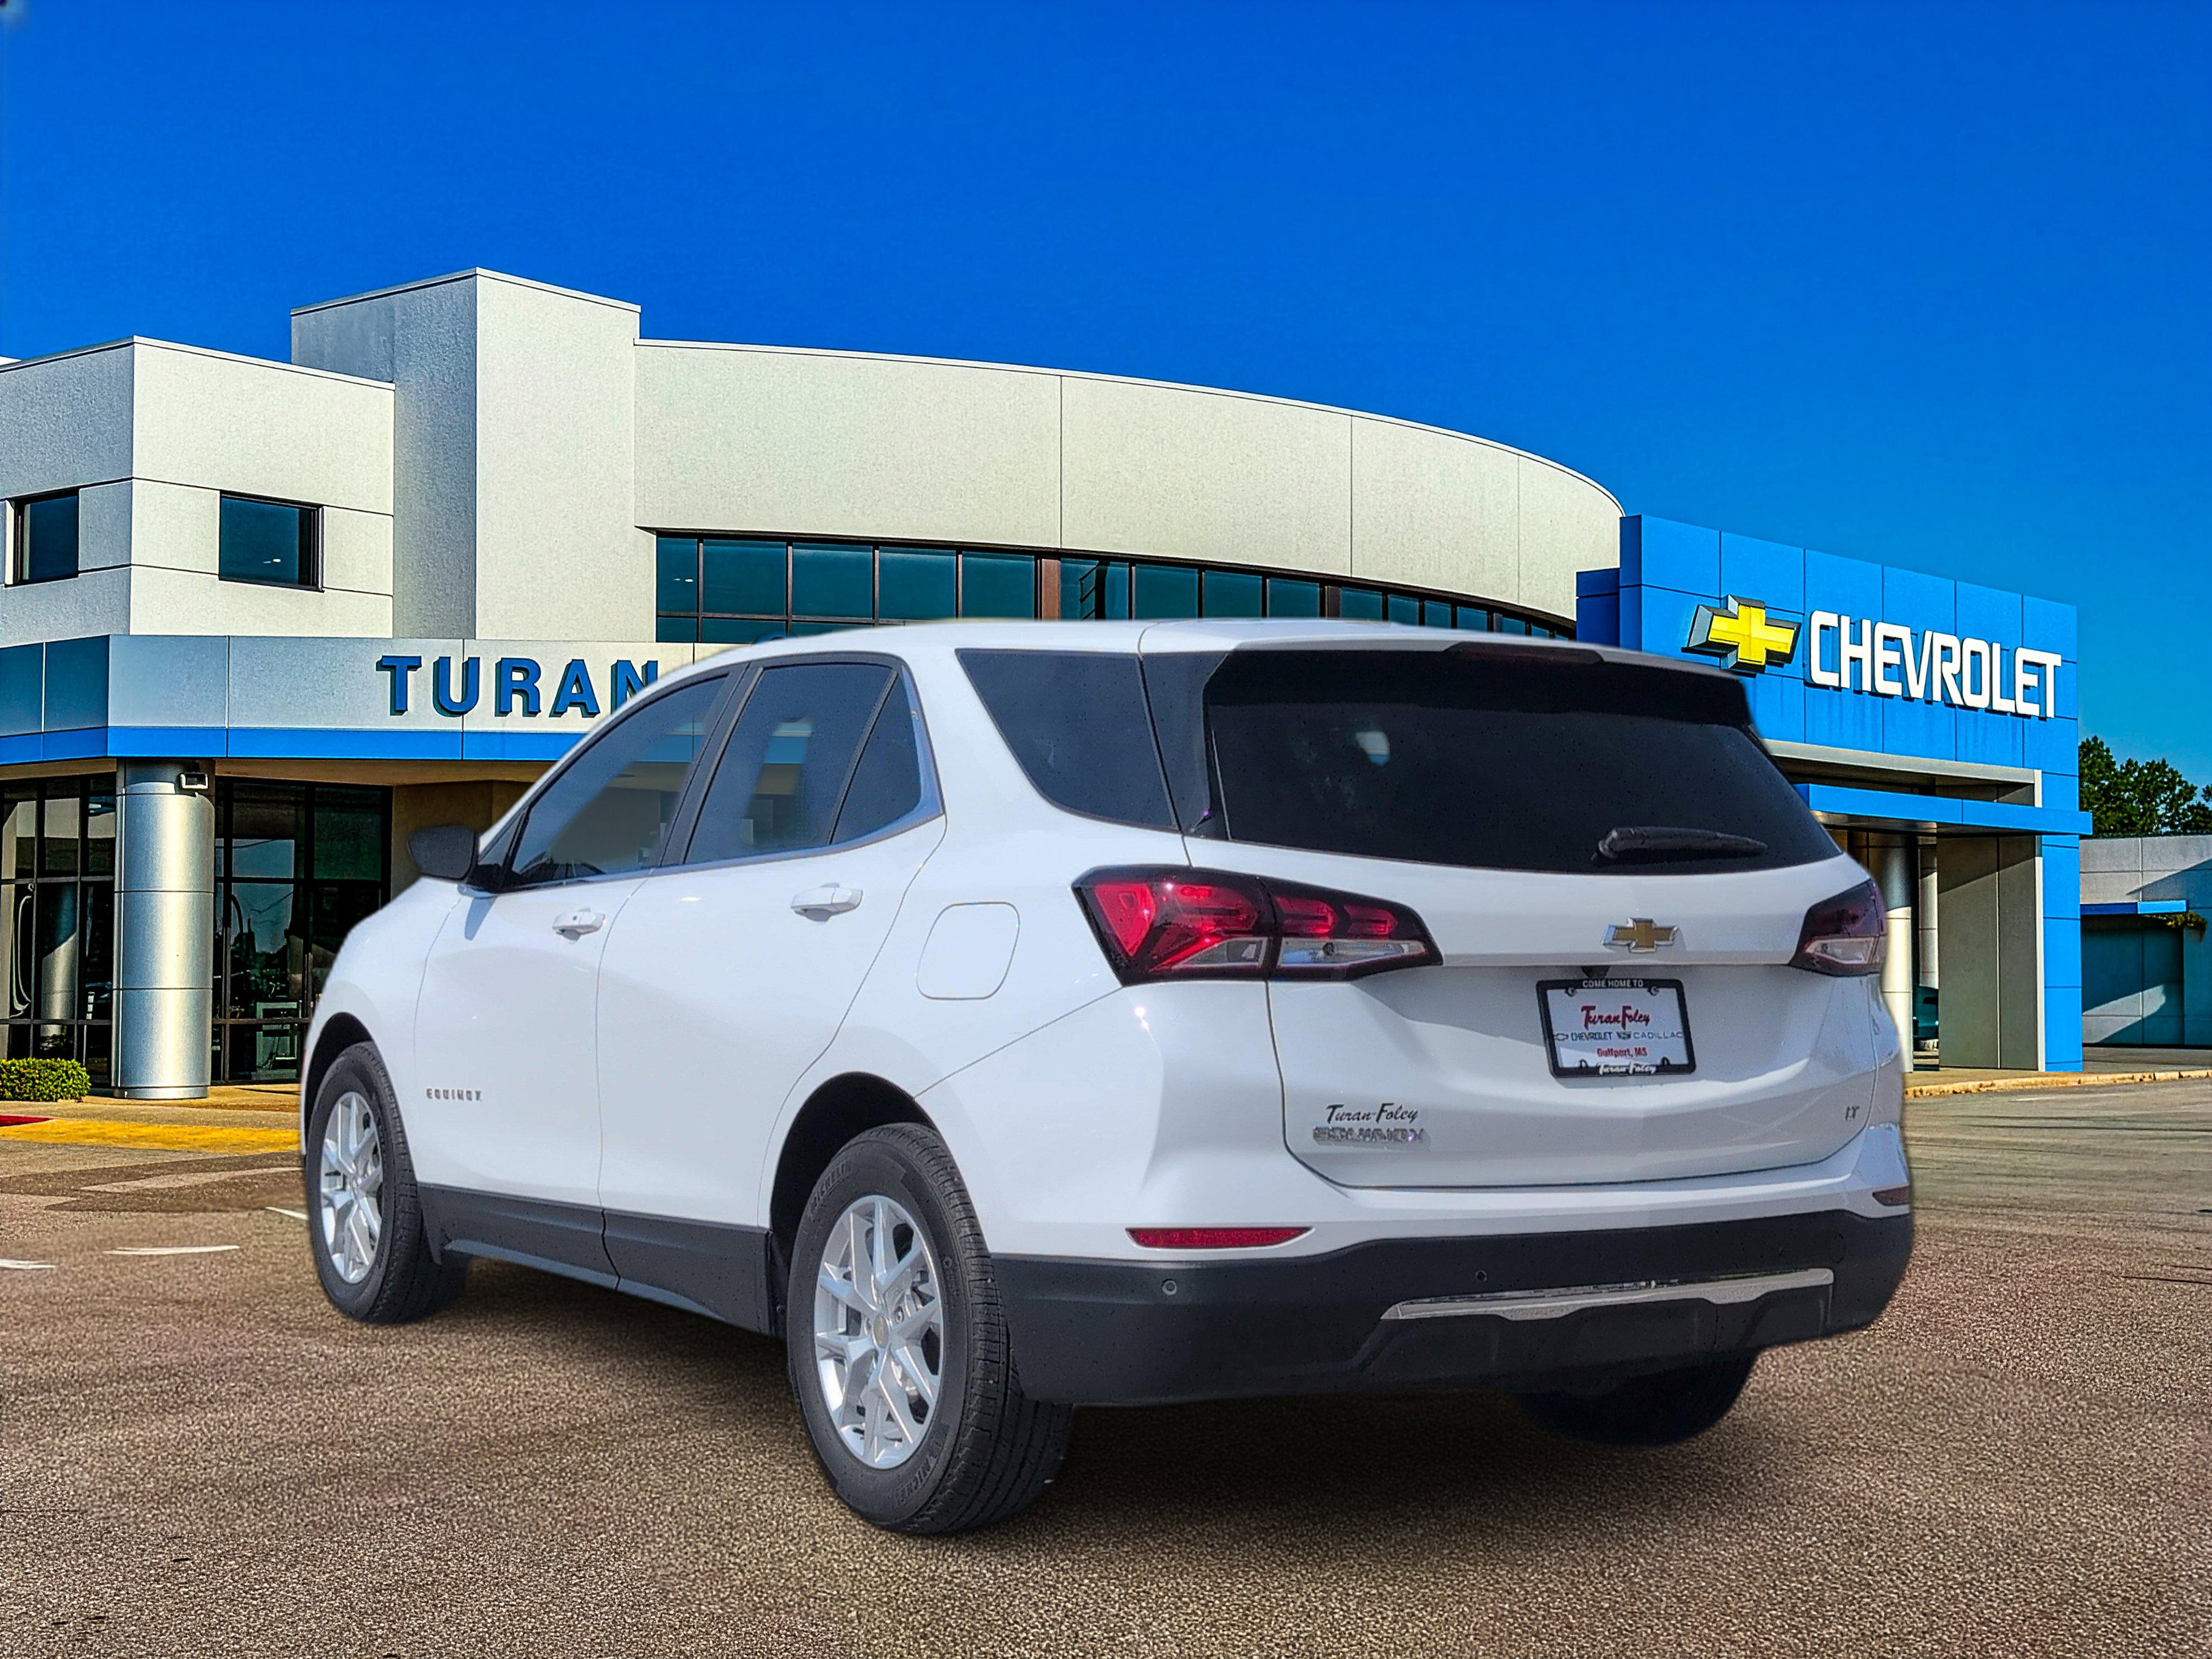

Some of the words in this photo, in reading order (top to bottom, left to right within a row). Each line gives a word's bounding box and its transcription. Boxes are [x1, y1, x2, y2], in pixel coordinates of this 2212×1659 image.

[1810, 610, 2062, 719] CHEVROLET
[376, 655, 658, 718] TURAN
[1583, 979, 1606, 987] COME
[1571, 1032, 1612, 1041] CHEVROLET
[1634, 1031, 1683, 1040] CADILLAC
[1634, 1047, 1648, 1056] MS
